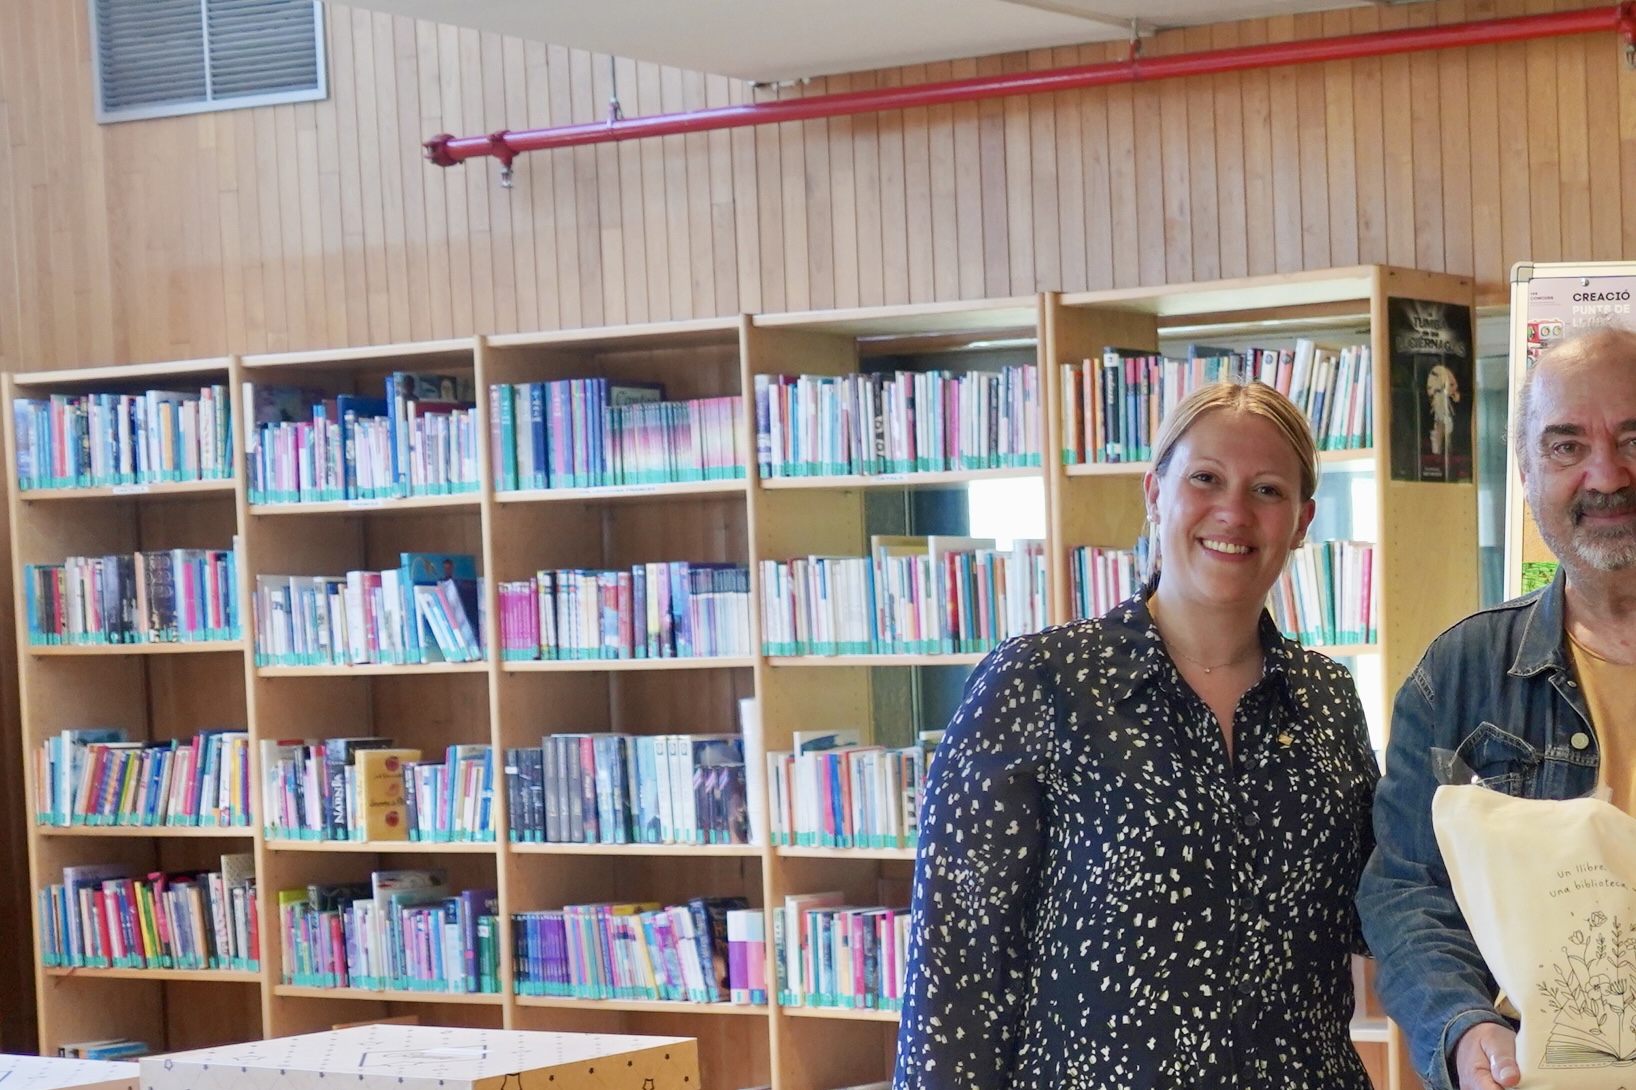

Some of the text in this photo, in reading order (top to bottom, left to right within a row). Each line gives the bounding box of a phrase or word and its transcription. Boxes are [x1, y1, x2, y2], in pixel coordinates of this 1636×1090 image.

[1572, 289, 1631, 302] CREACIÓ
[1572, 303, 1631, 315] PUNTS DE
